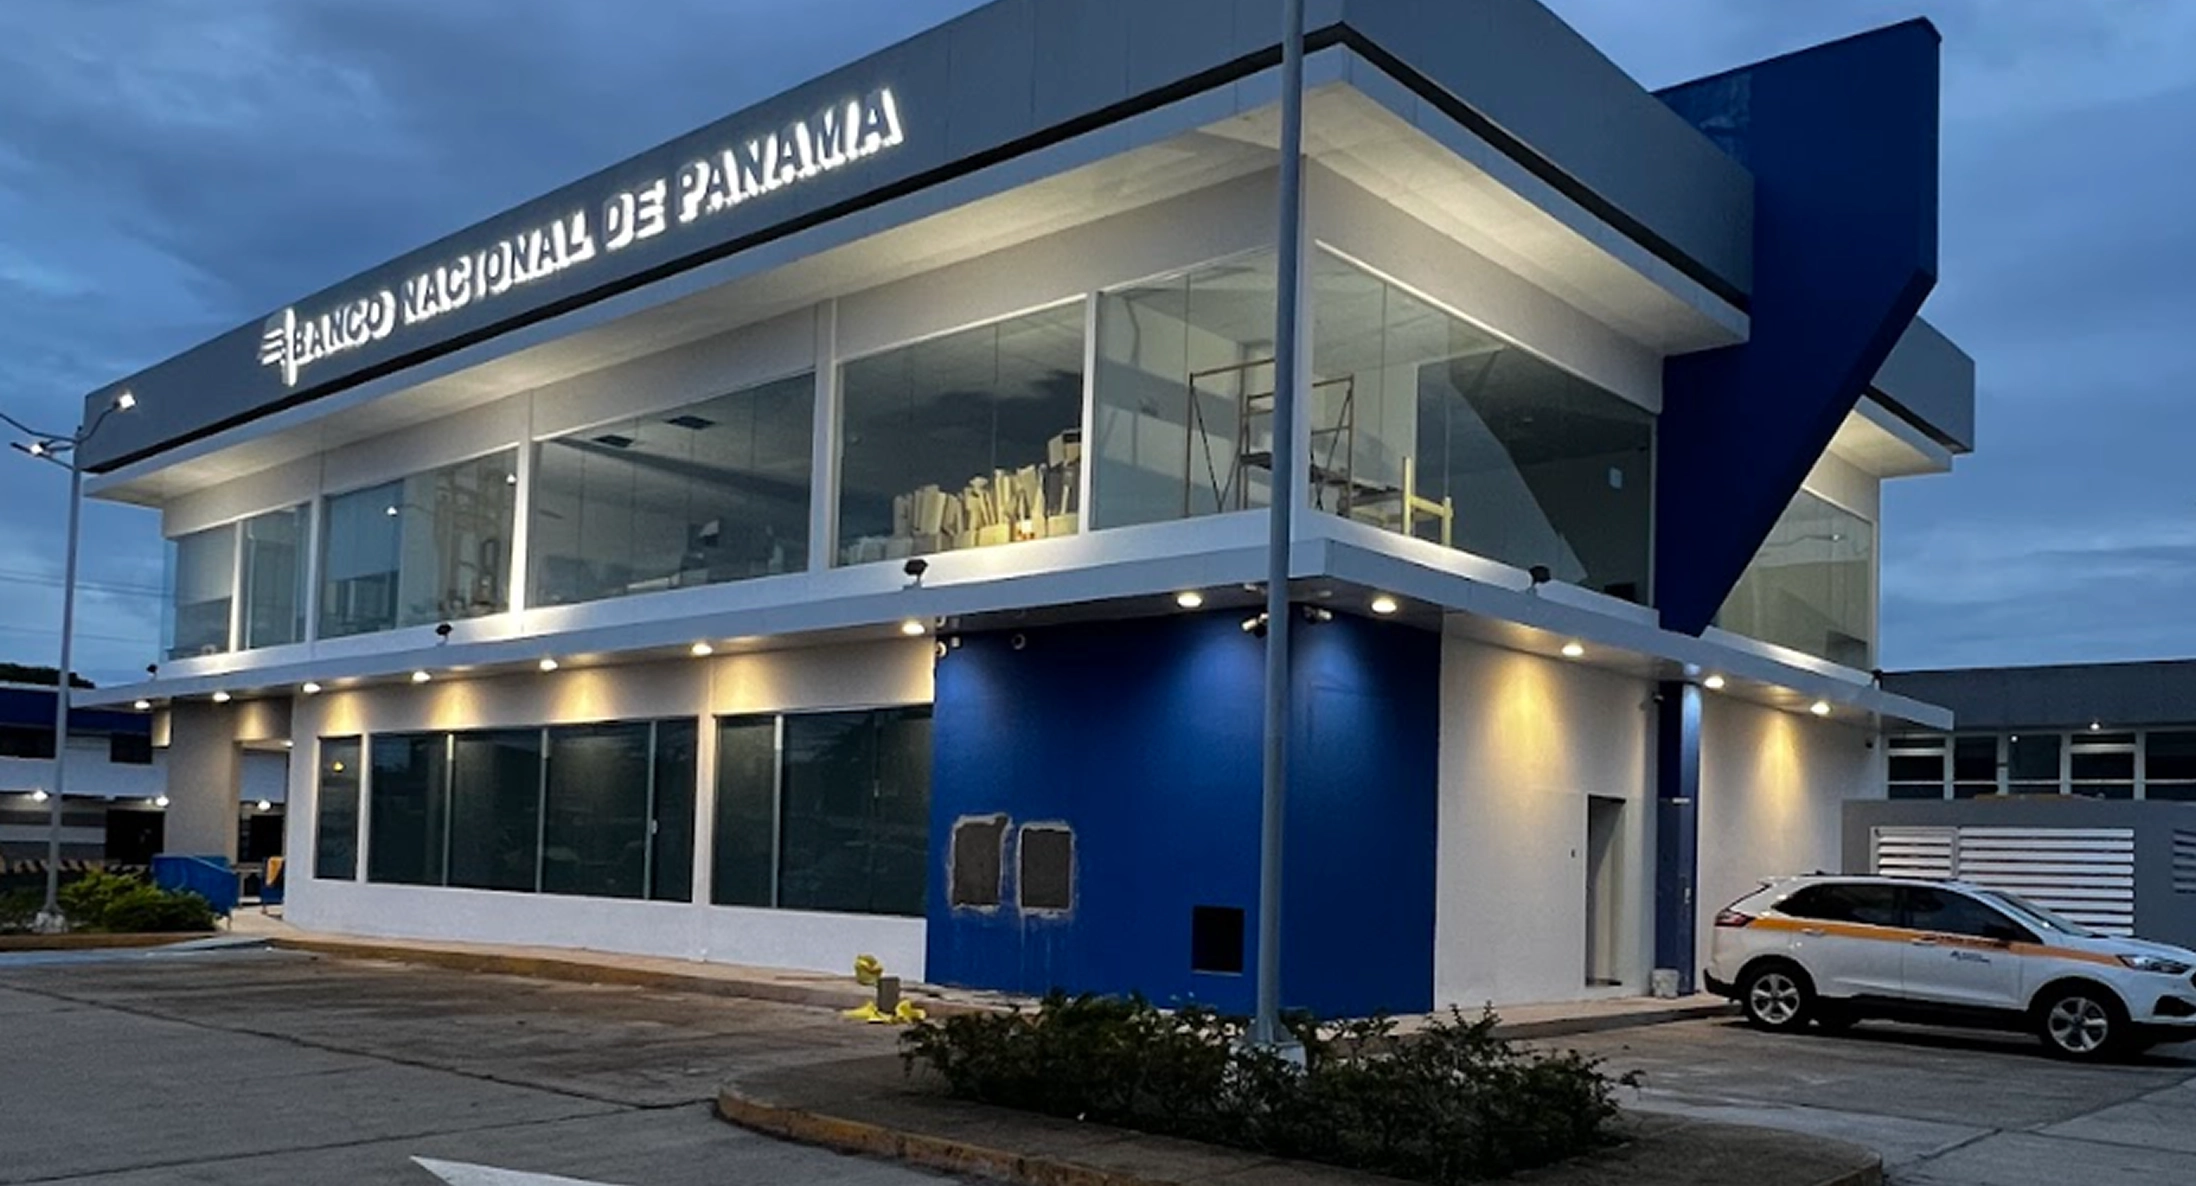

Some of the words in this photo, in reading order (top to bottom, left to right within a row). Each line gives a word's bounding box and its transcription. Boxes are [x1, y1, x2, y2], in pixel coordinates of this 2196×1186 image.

[292, 289, 396, 366] BANCO
[402, 208, 596, 325] NACIONAL
[602, 178, 667, 251] DE
[676, 87, 904, 222] PANAMA
